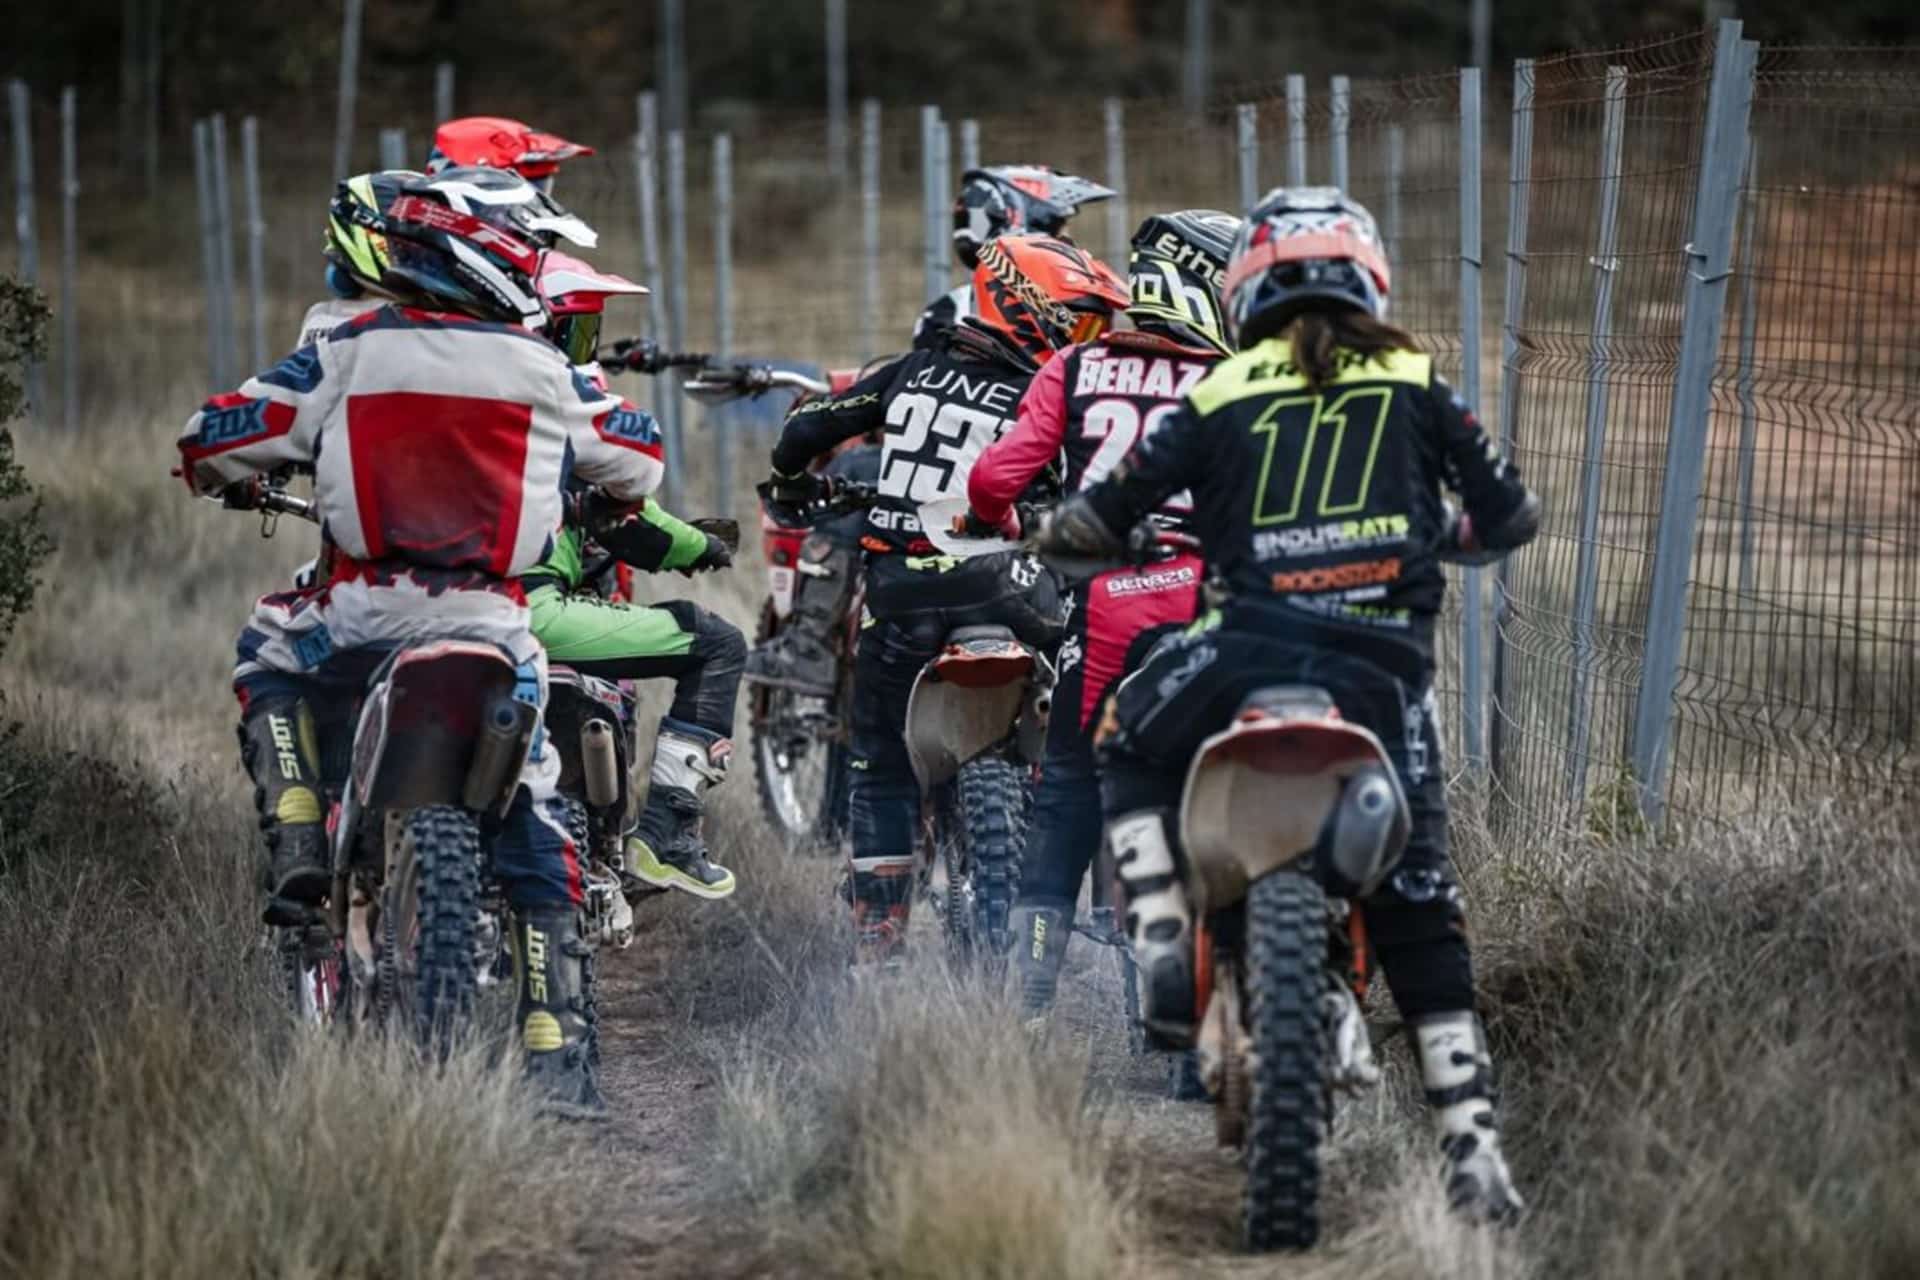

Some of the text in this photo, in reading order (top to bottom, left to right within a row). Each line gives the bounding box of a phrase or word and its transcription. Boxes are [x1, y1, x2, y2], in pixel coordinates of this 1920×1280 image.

[907, 365, 1020, 412] JUNE
[200, 396, 270, 447] FOX
[604, 406, 660, 445] FOX
[877, 392, 1018, 504] 23
[1251, 386, 1393, 526] 11
[267, 713, 302, 781] SHOT
[526, 923, 548, 1003] SHOT
[1032, 914, 1046, 960] SHOT
